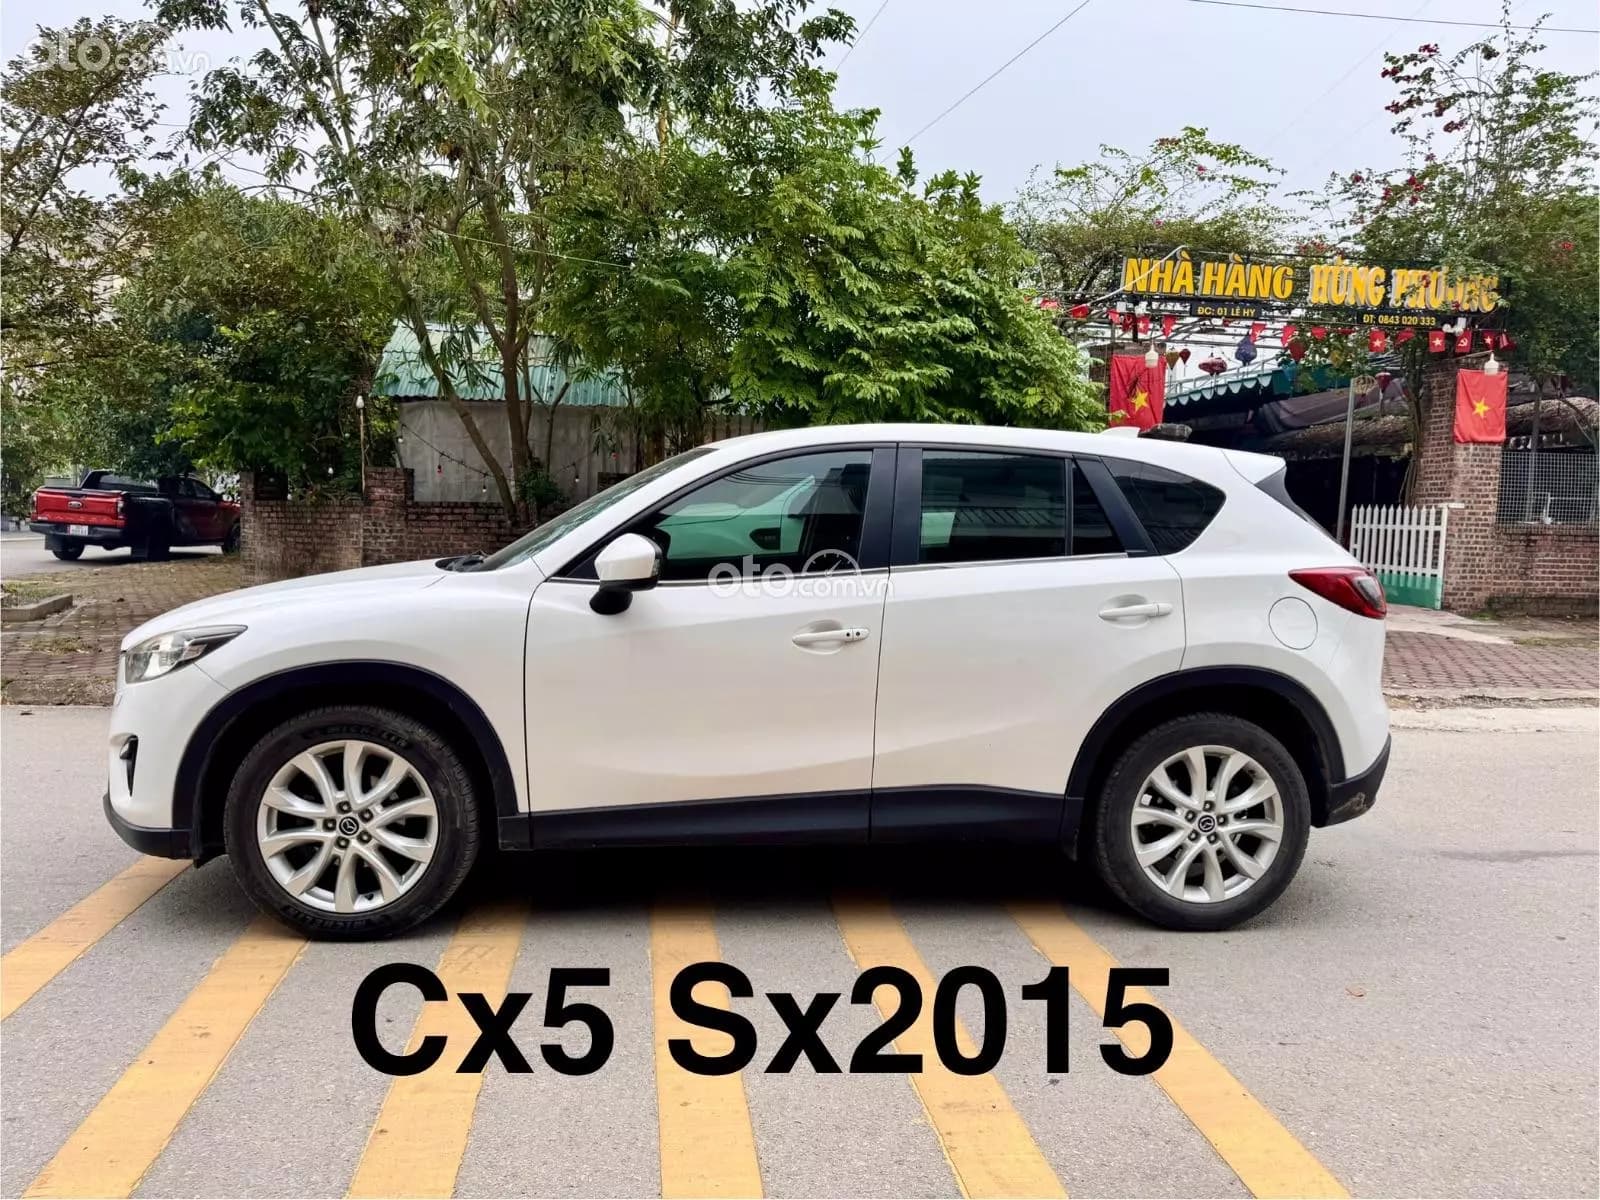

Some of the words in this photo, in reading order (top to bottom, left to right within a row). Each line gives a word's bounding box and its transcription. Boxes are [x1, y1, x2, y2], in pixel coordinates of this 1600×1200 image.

[1122, 250, 1195, 296] NHÀ
[1201, 252, 1294, 299] HÀNG
[1217, 307, 1228, 316] 01
[1242, 307, 1256, 317] HY
[1378, 314, 1400, 325] 0843
[1402, 315, 1418, 325] 020
[1420, 316, 1437, 326] 333
